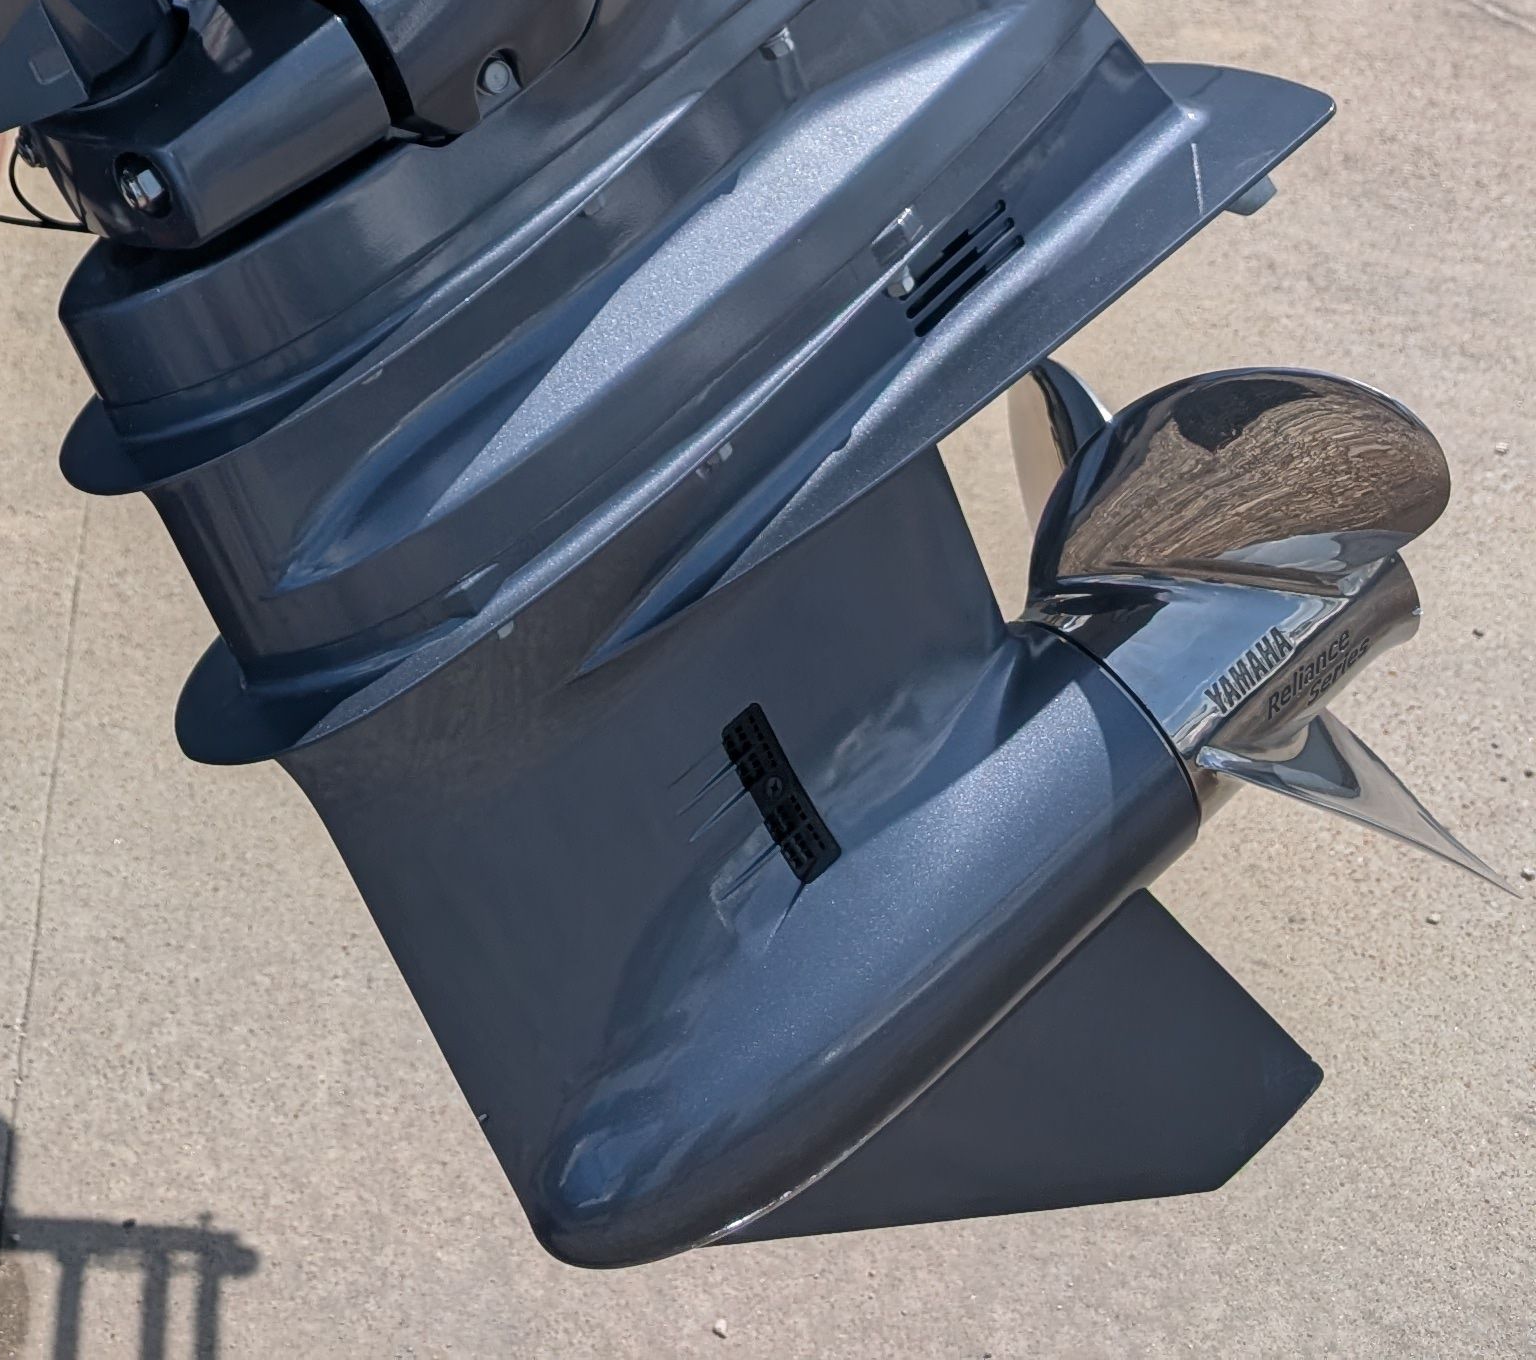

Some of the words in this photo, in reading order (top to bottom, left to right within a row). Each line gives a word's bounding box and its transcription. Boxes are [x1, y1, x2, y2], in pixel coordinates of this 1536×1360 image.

[1204, 626, 1294, 715] YAMAHA
[1267, 629, 1351, 721] Reliance
[1308, 637, 1370, 706] Series
